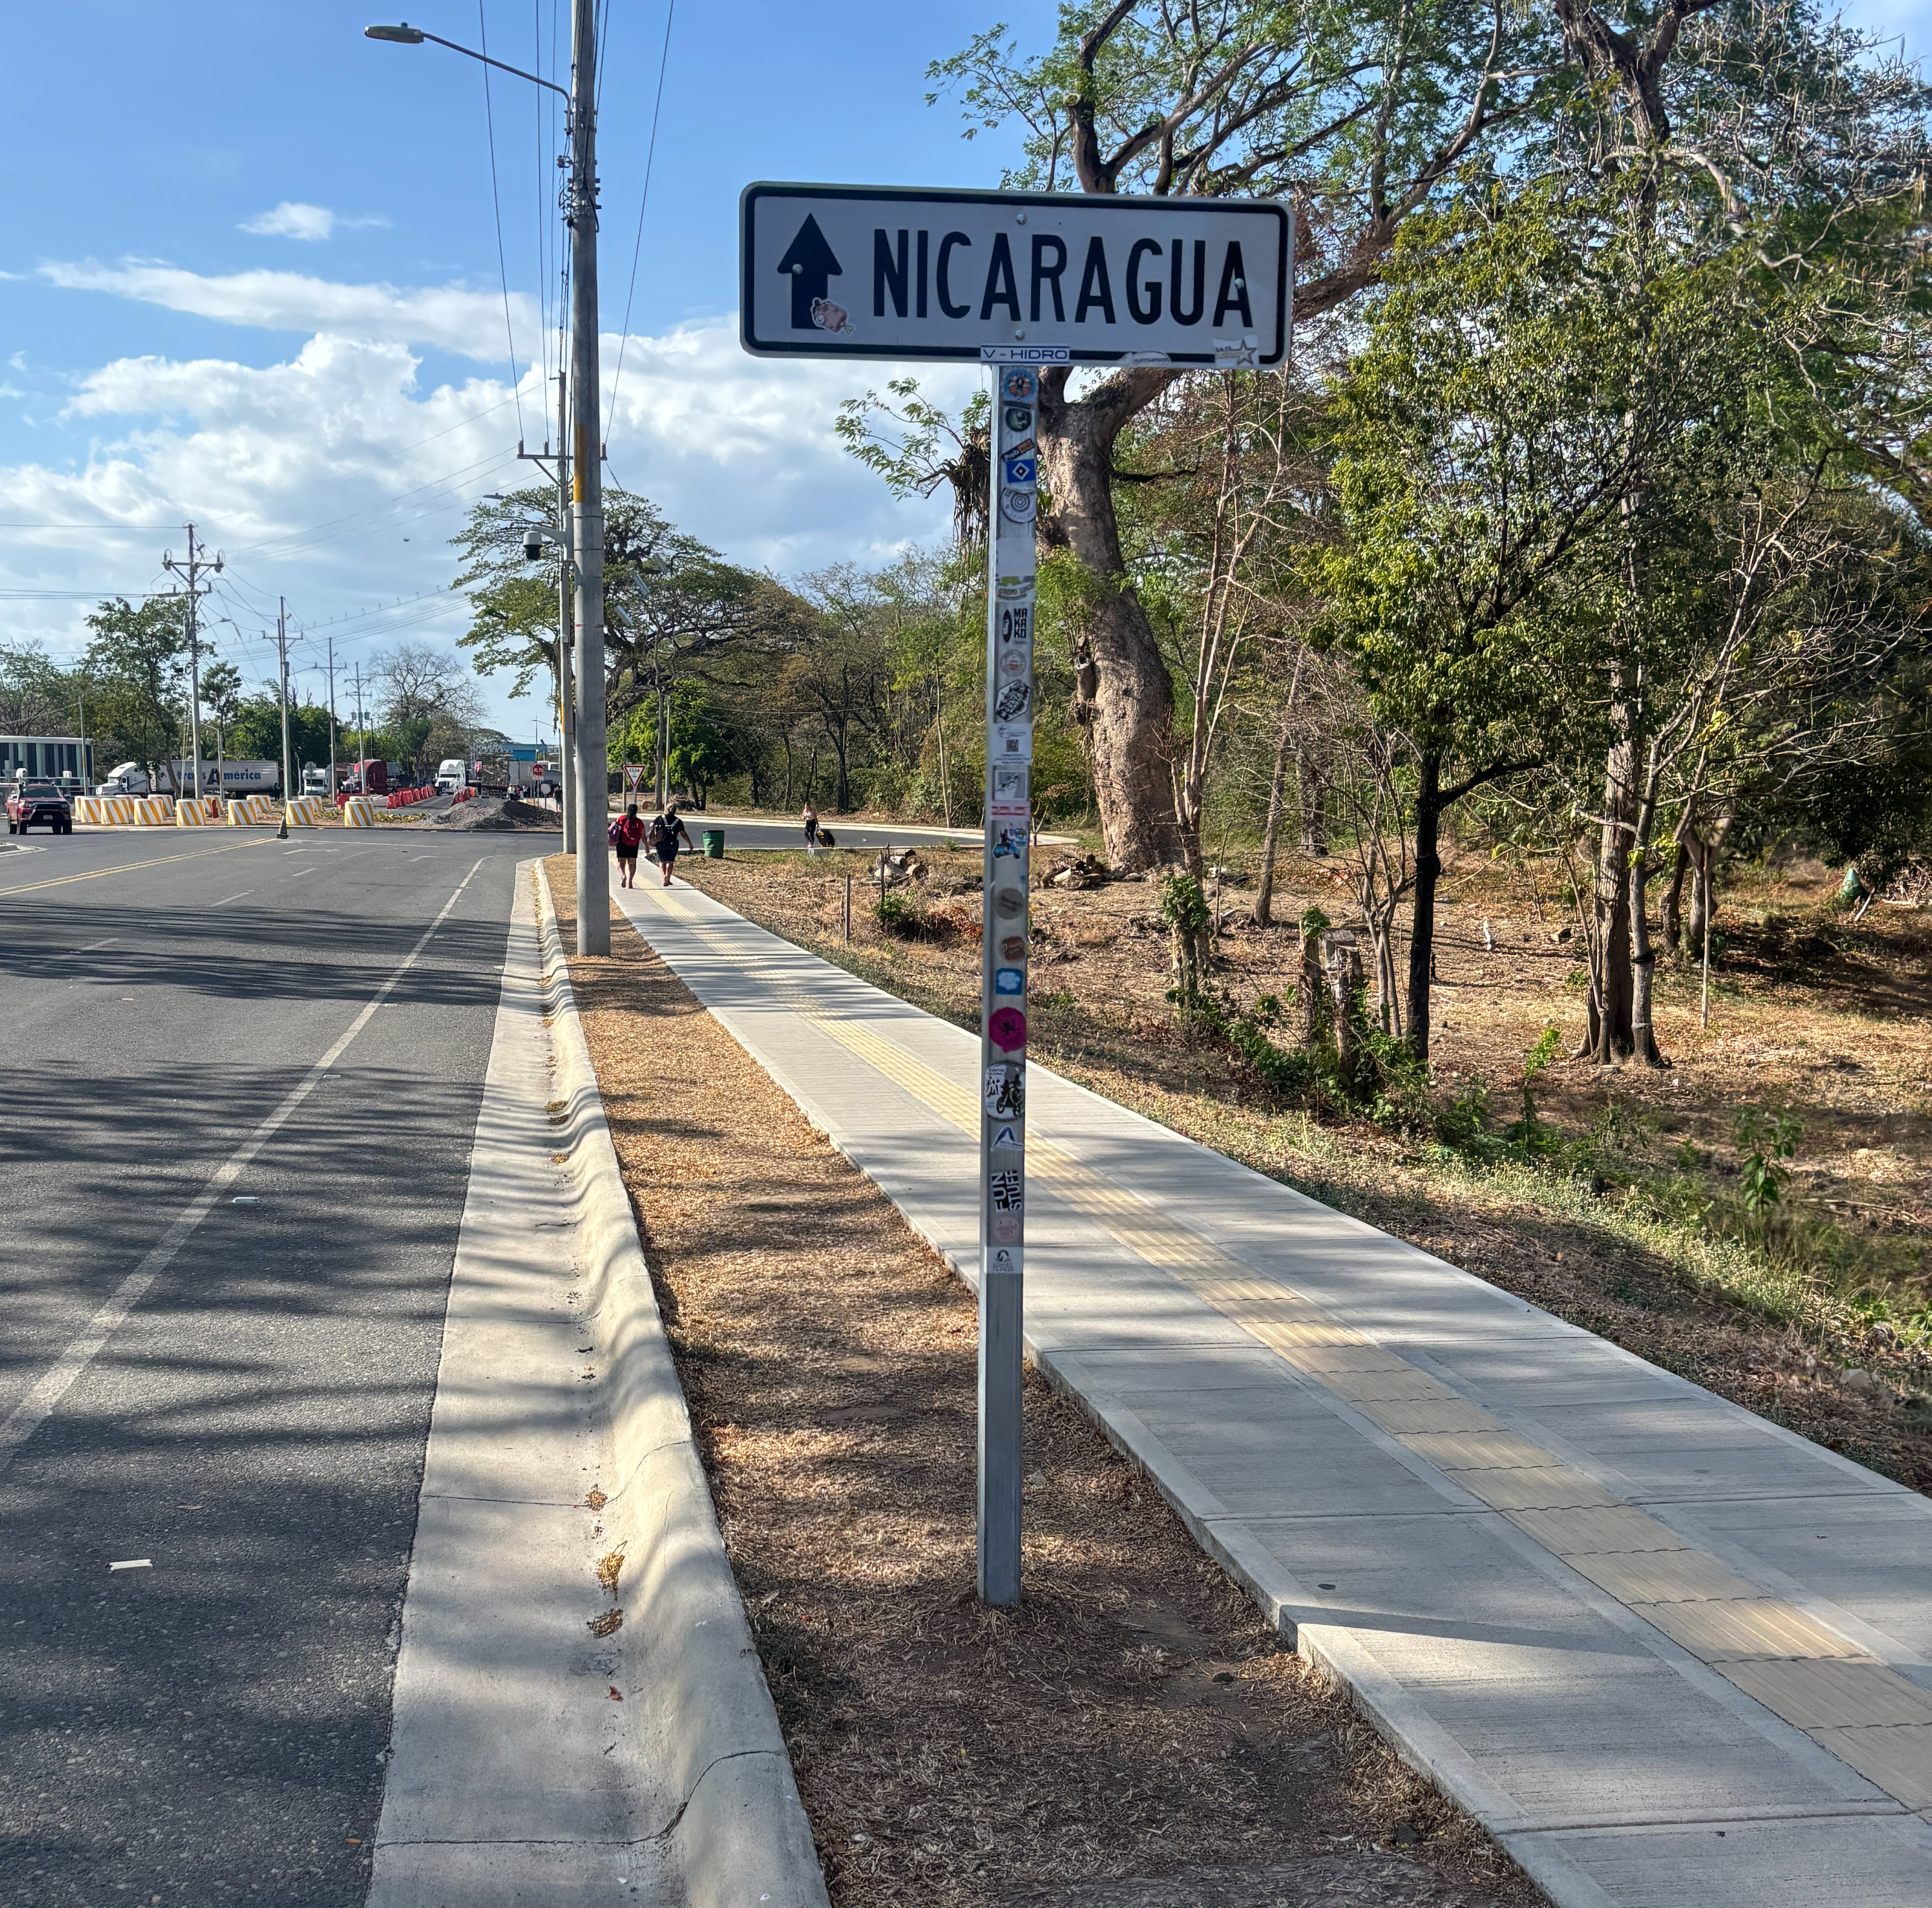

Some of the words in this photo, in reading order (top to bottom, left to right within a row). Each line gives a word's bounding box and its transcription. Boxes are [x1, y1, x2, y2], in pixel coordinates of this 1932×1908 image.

[873, 228, 1253, 328] NICARAGUA
[983, 349, 995, 358] V
[1010, 349, 1068, 359] HIDRO
[990, 1173, 1007, 1212] FUN
[1004, 1170, 1023, 1211] STUFF
